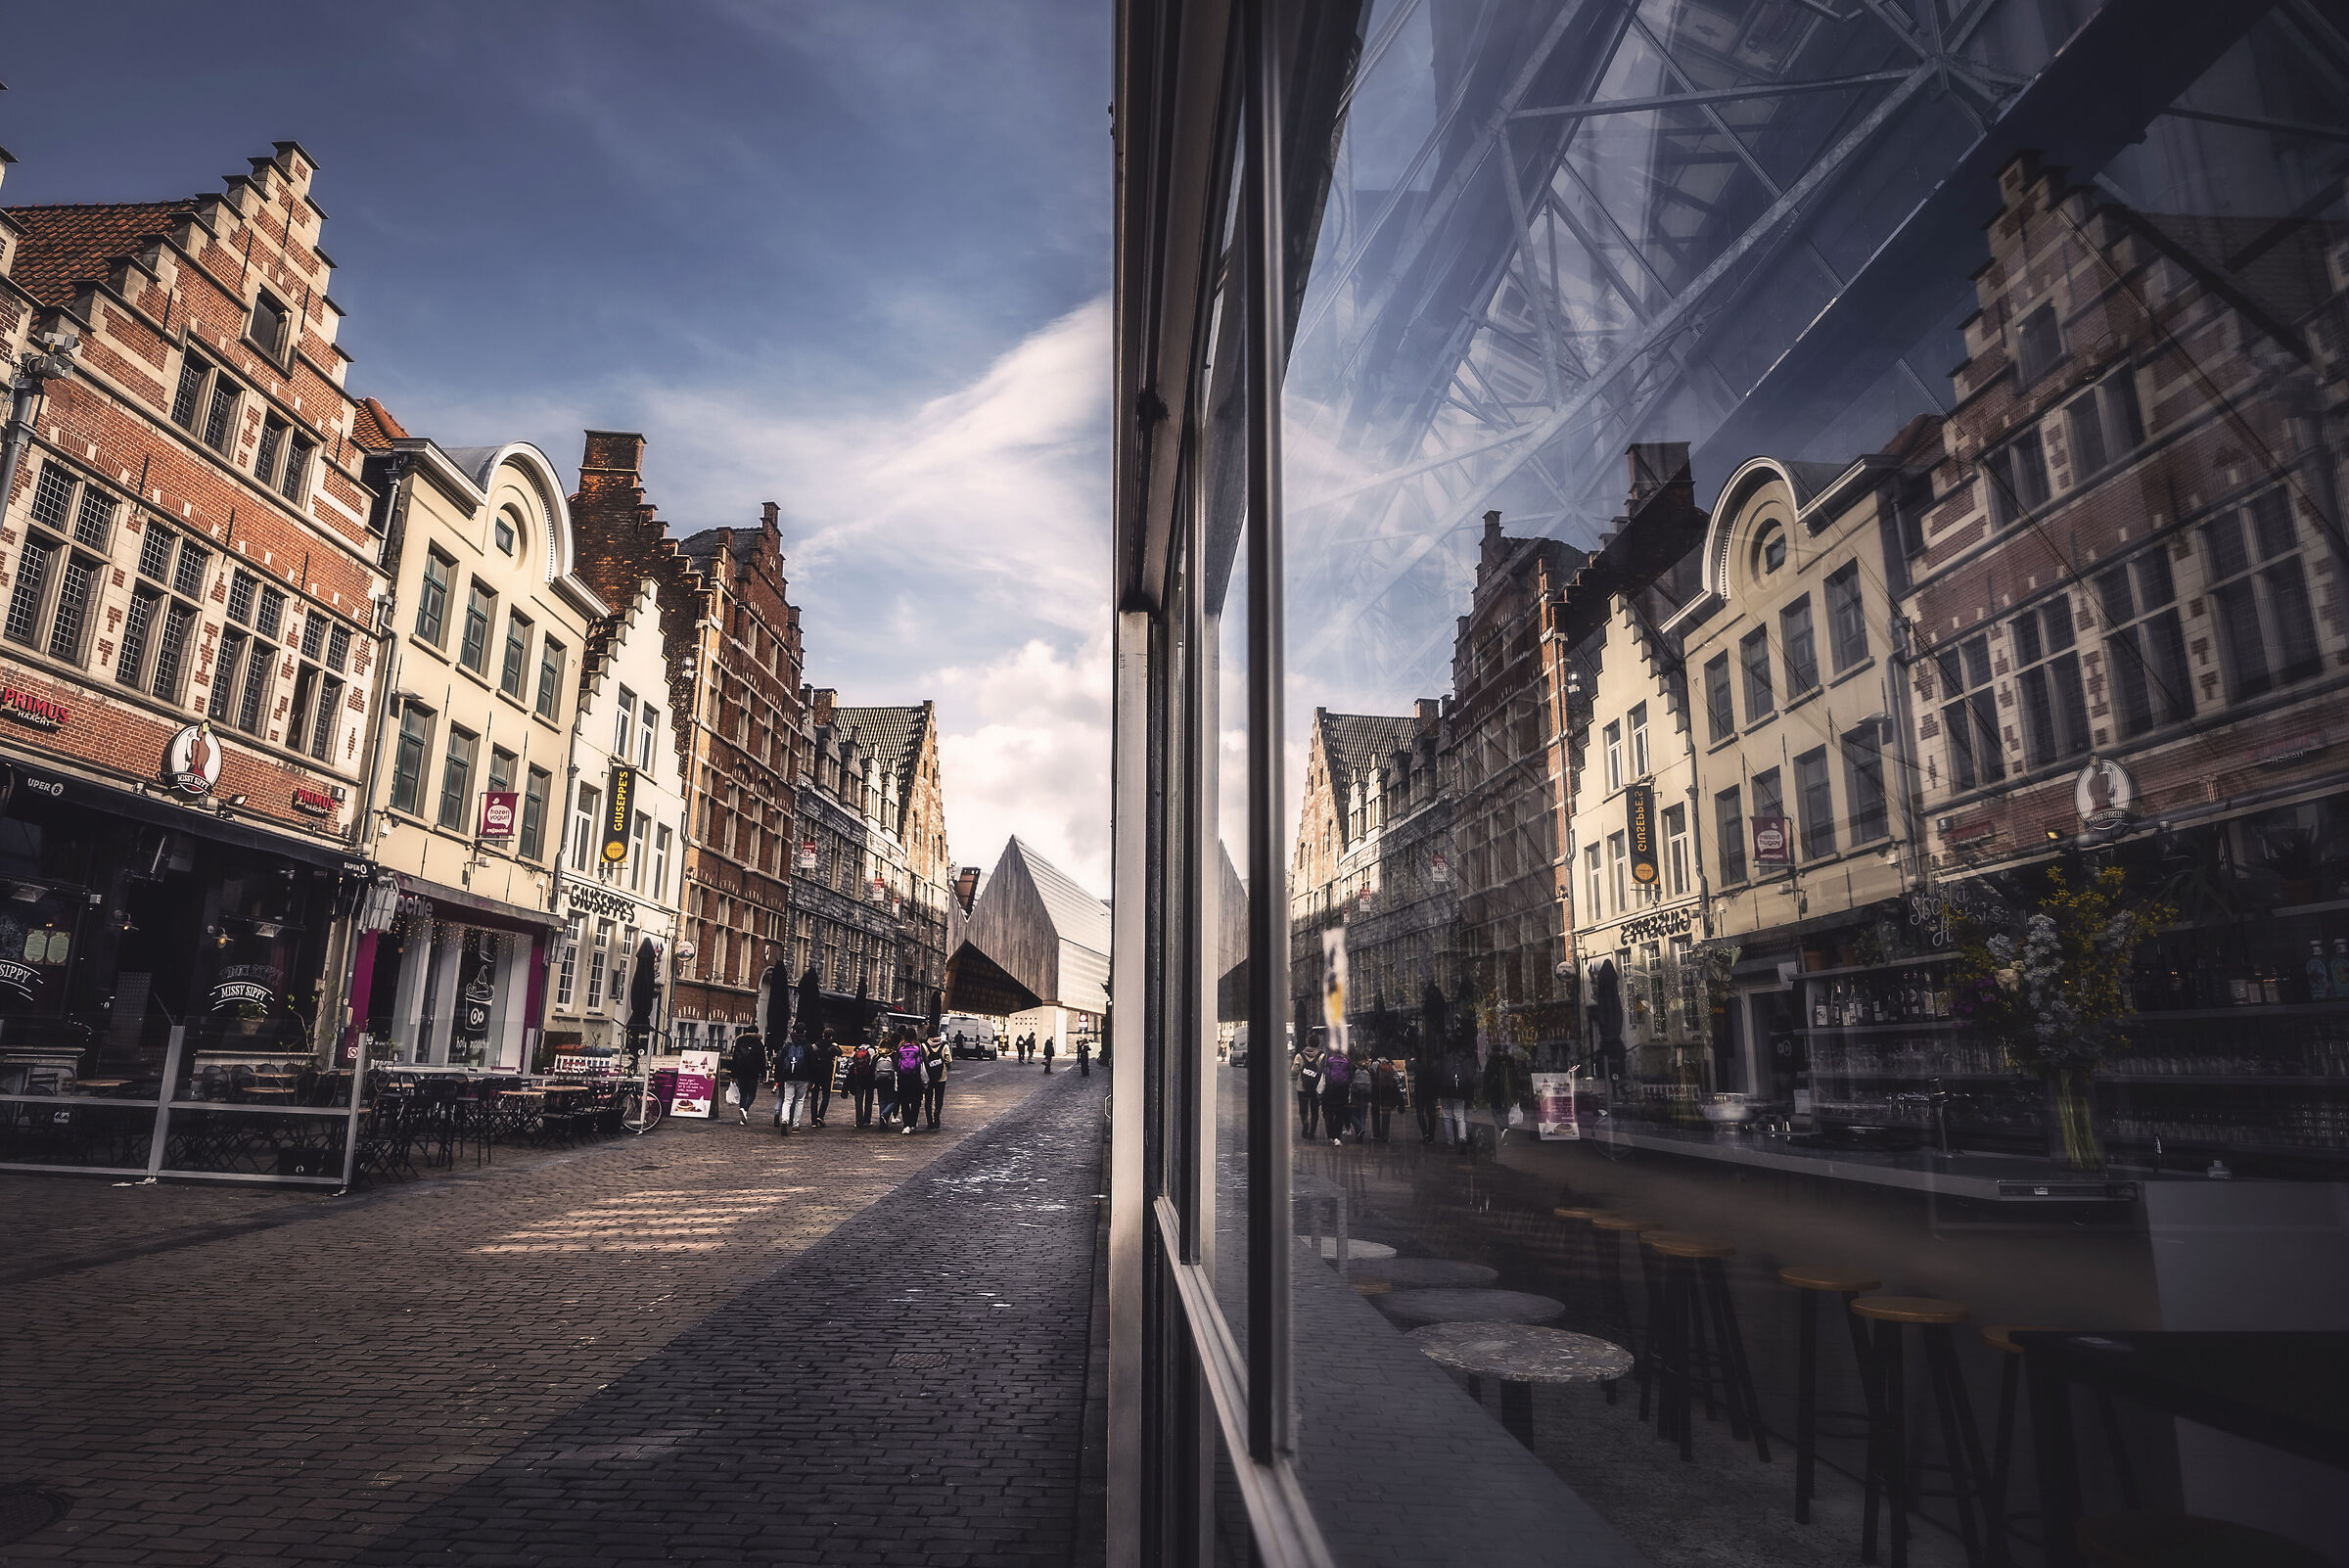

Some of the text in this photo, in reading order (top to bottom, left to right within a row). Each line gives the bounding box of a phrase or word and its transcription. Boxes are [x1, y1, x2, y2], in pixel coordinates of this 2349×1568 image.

[3, 687, 69, 722] PRIMUS
[17, 711, 52, 726] HAACHT
[297, 788, 338, 810] PRIMUS
[614, 770, 628, 832] GIUSEPPE'S
[569, 884, 636, 923] GIUSEPPE'S
[0, 963, 32, 984] SIPPY
[221, 985, 267, 1001] MISSY SIPPY
